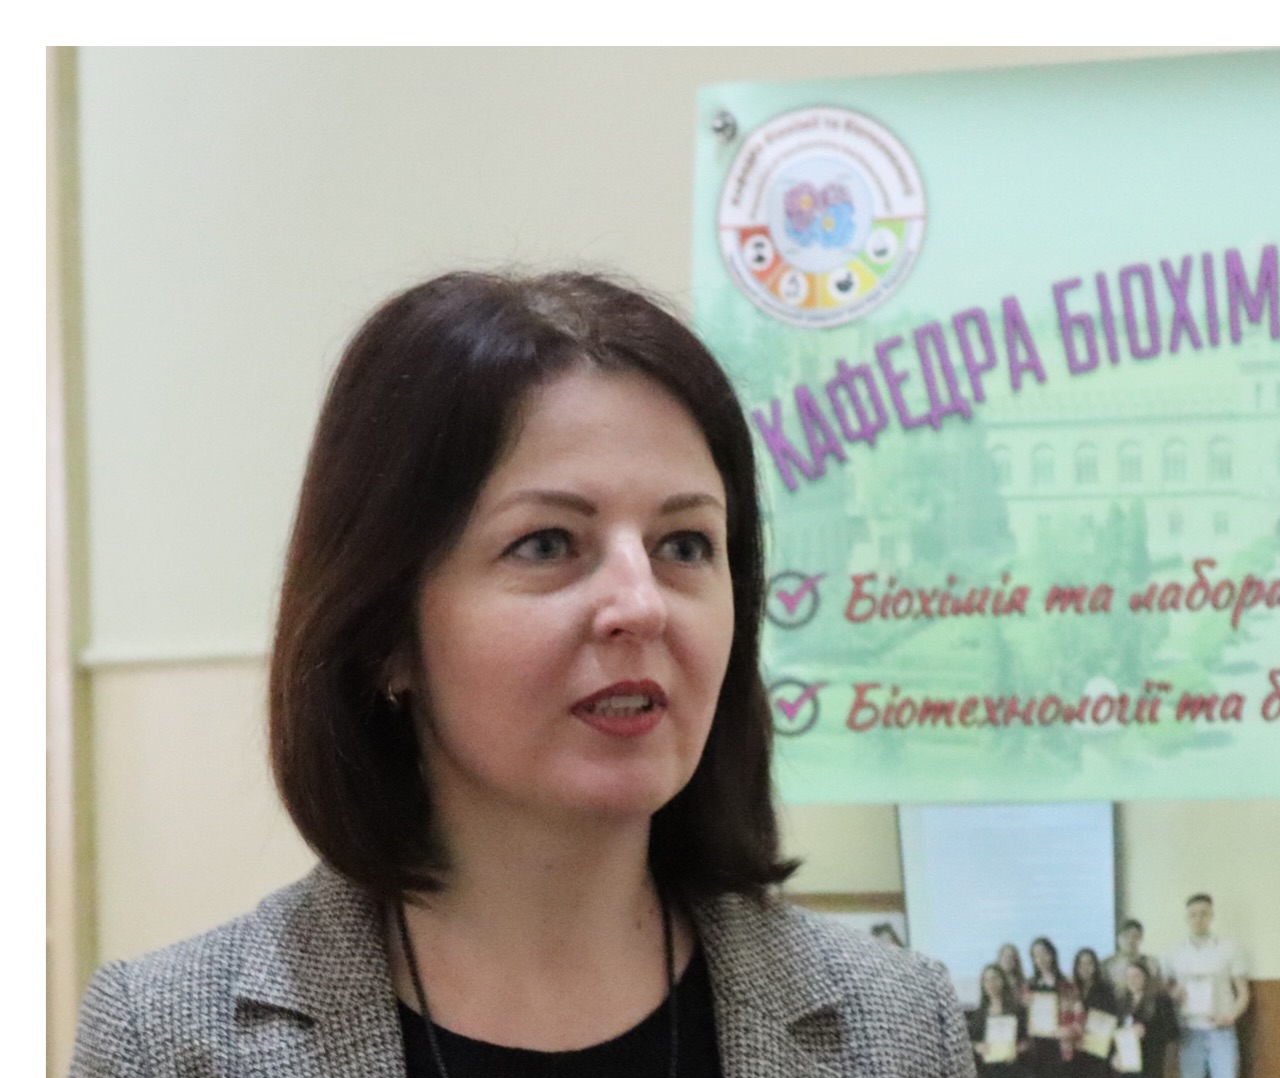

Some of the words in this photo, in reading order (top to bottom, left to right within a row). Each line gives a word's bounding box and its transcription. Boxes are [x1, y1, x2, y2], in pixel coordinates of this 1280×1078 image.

[751, 296, 1046, 491] КАФЕДРА
[844, 572, 1030, 624] Біохімія
[1044, 582, 1115, 616] та
[845, 679, 1171, 732] Біотехнології
[1175, 690, 1246, 723] та
